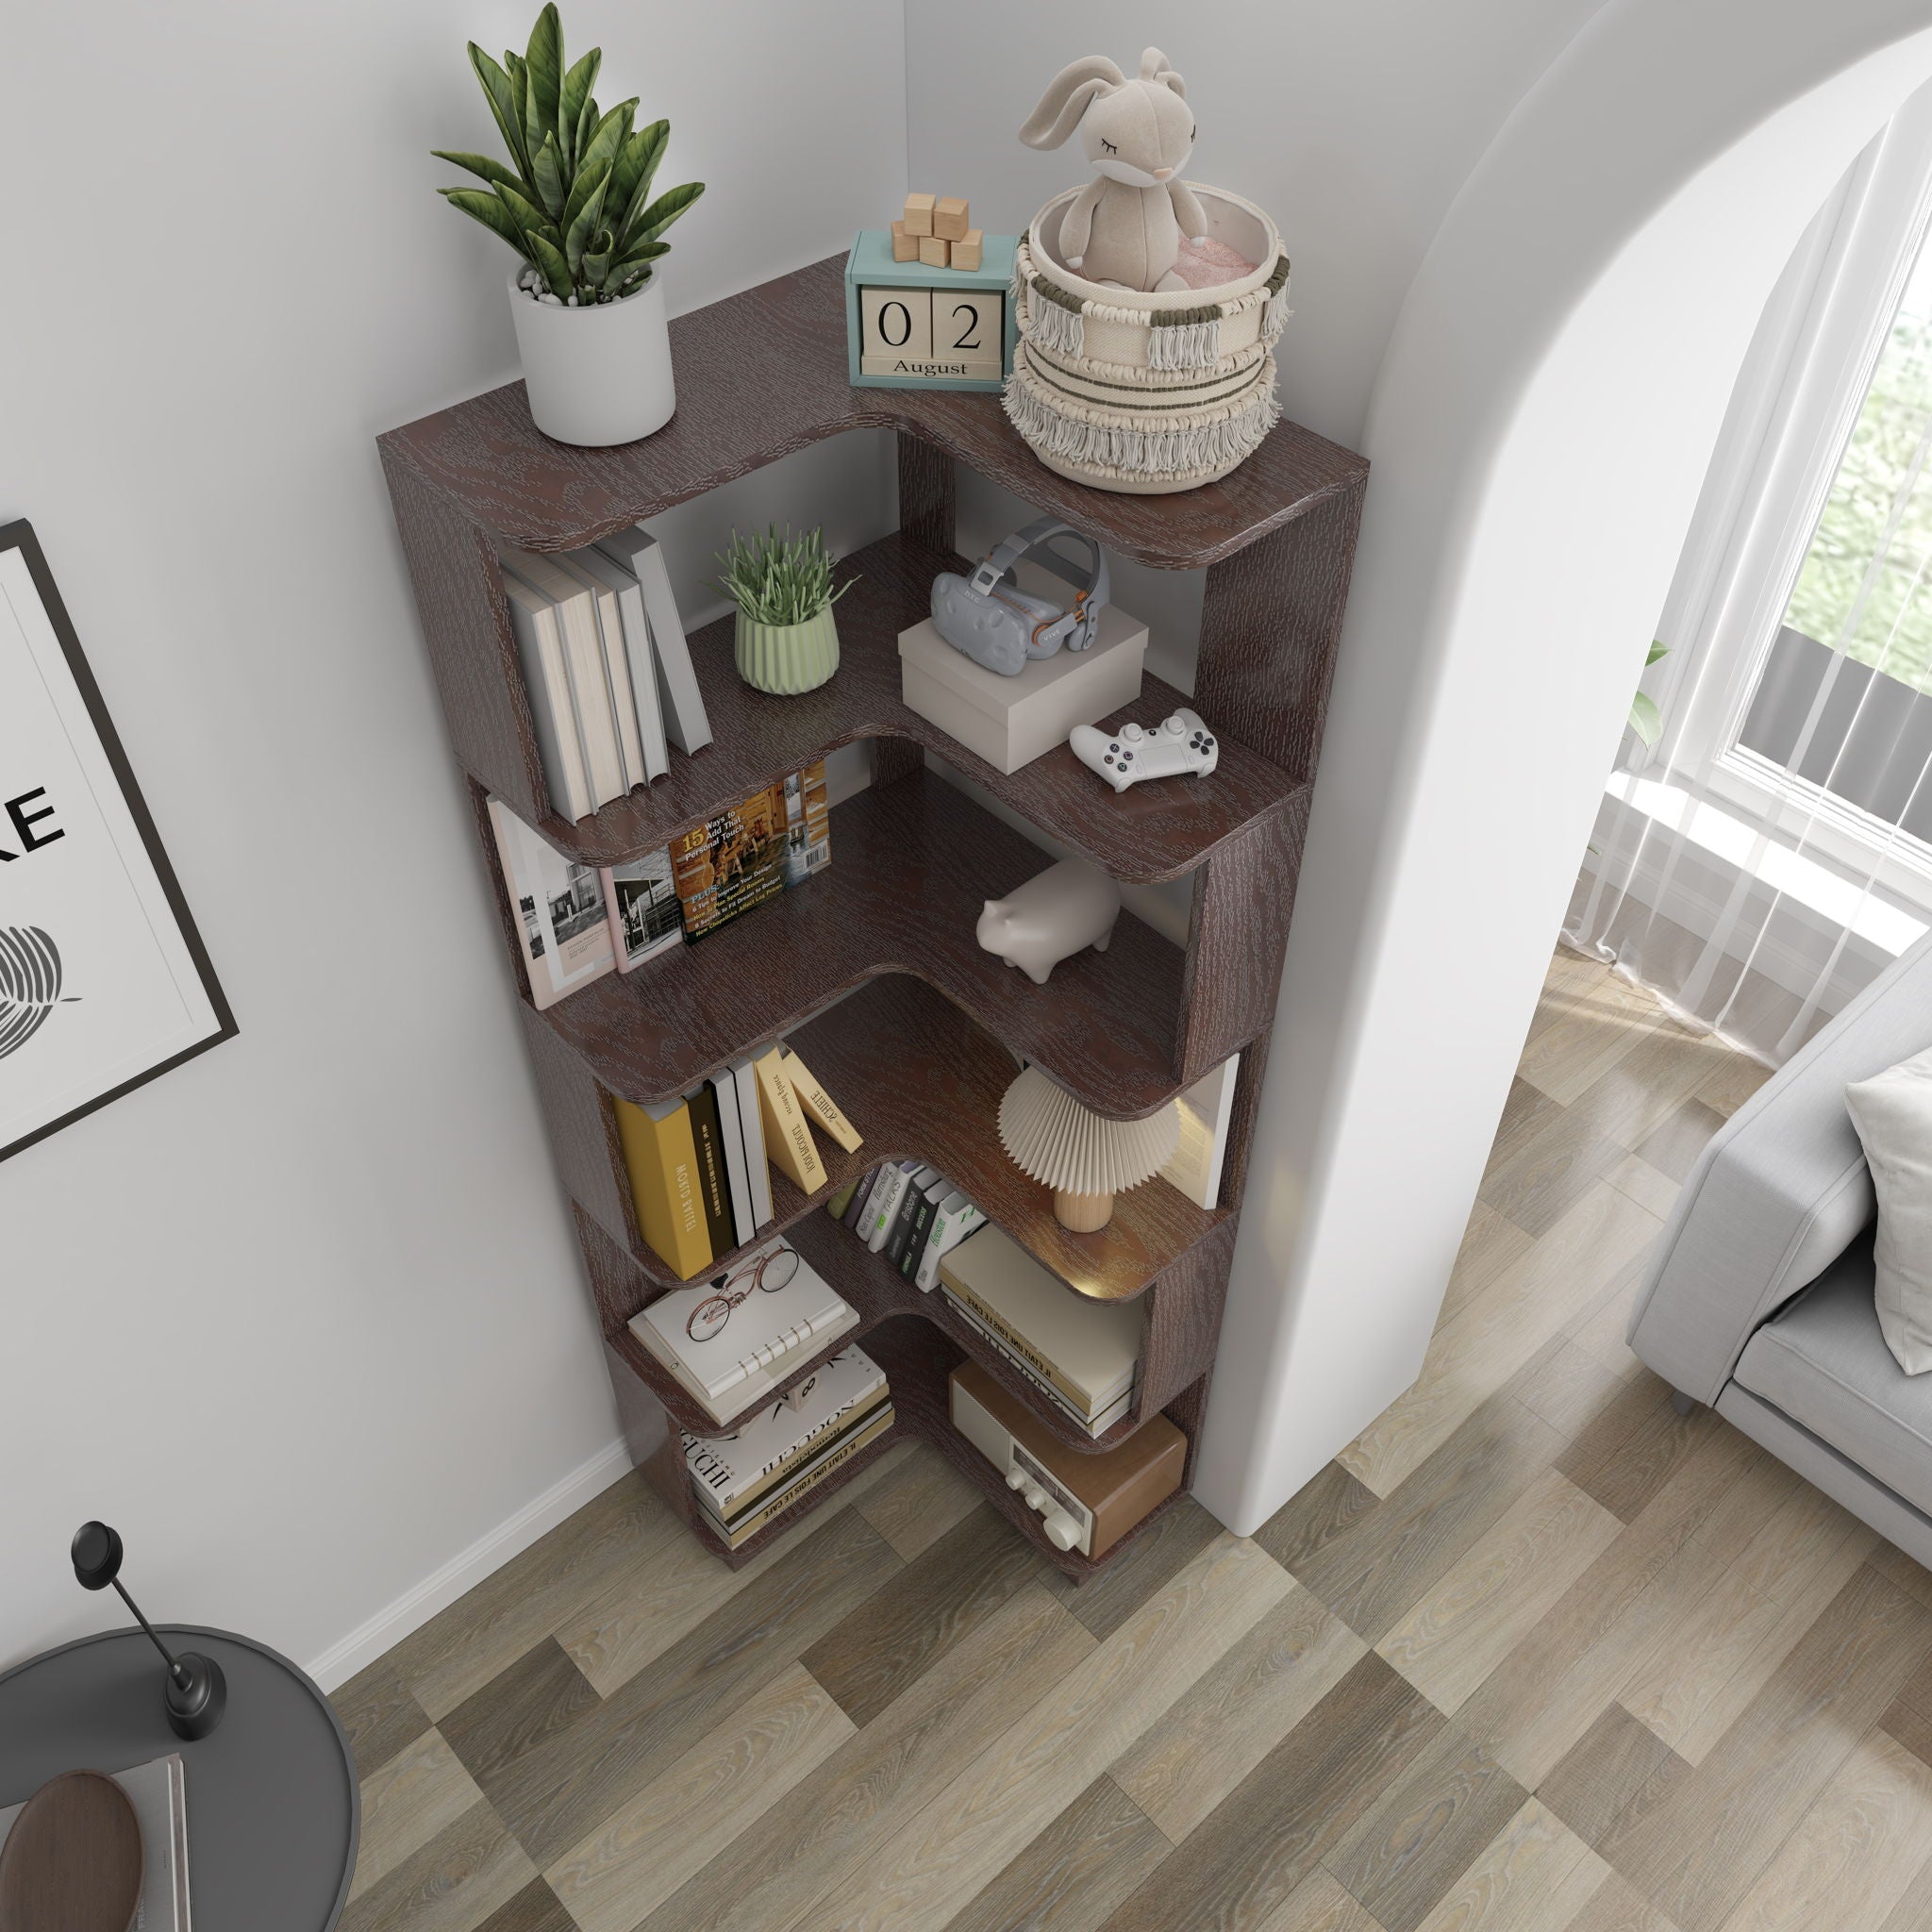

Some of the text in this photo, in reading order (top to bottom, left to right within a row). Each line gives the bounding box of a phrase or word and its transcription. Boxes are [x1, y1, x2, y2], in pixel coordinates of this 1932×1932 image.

[893, 359, 969, 376] August
[0, 786, 65, 861] E
[682, 829, 705, 852] 15
[705, 817, 724, 830] Ways
[706, 817, 741, 840] Add That
[685, 825, 744, 860] Personal Touch
[698, 901, 709, 910] Tips
[718, 883, 740, 898] Improve
[741, 875, 753, 884] Your
[726, 889, 746, 901] Special
[747, 878, 765, 889] Rooms
[737, 892, 755, 904] Dream
[762, 876, 781, 889] Budget
[739, 901, 755, 911] Affect
[883, 1181, 901, 1212] TALKS
[901, 1191, 918, 1221] Brisbane
[761, 1398, 855, 1476] NOGUCHI
[782, 1425, 841, 1474] Remodelista
[794, 1475, 810, 1495] FOIS
[811, 1463, 826, 1482] UNE
[784, 1490, 792, 1503] LE
